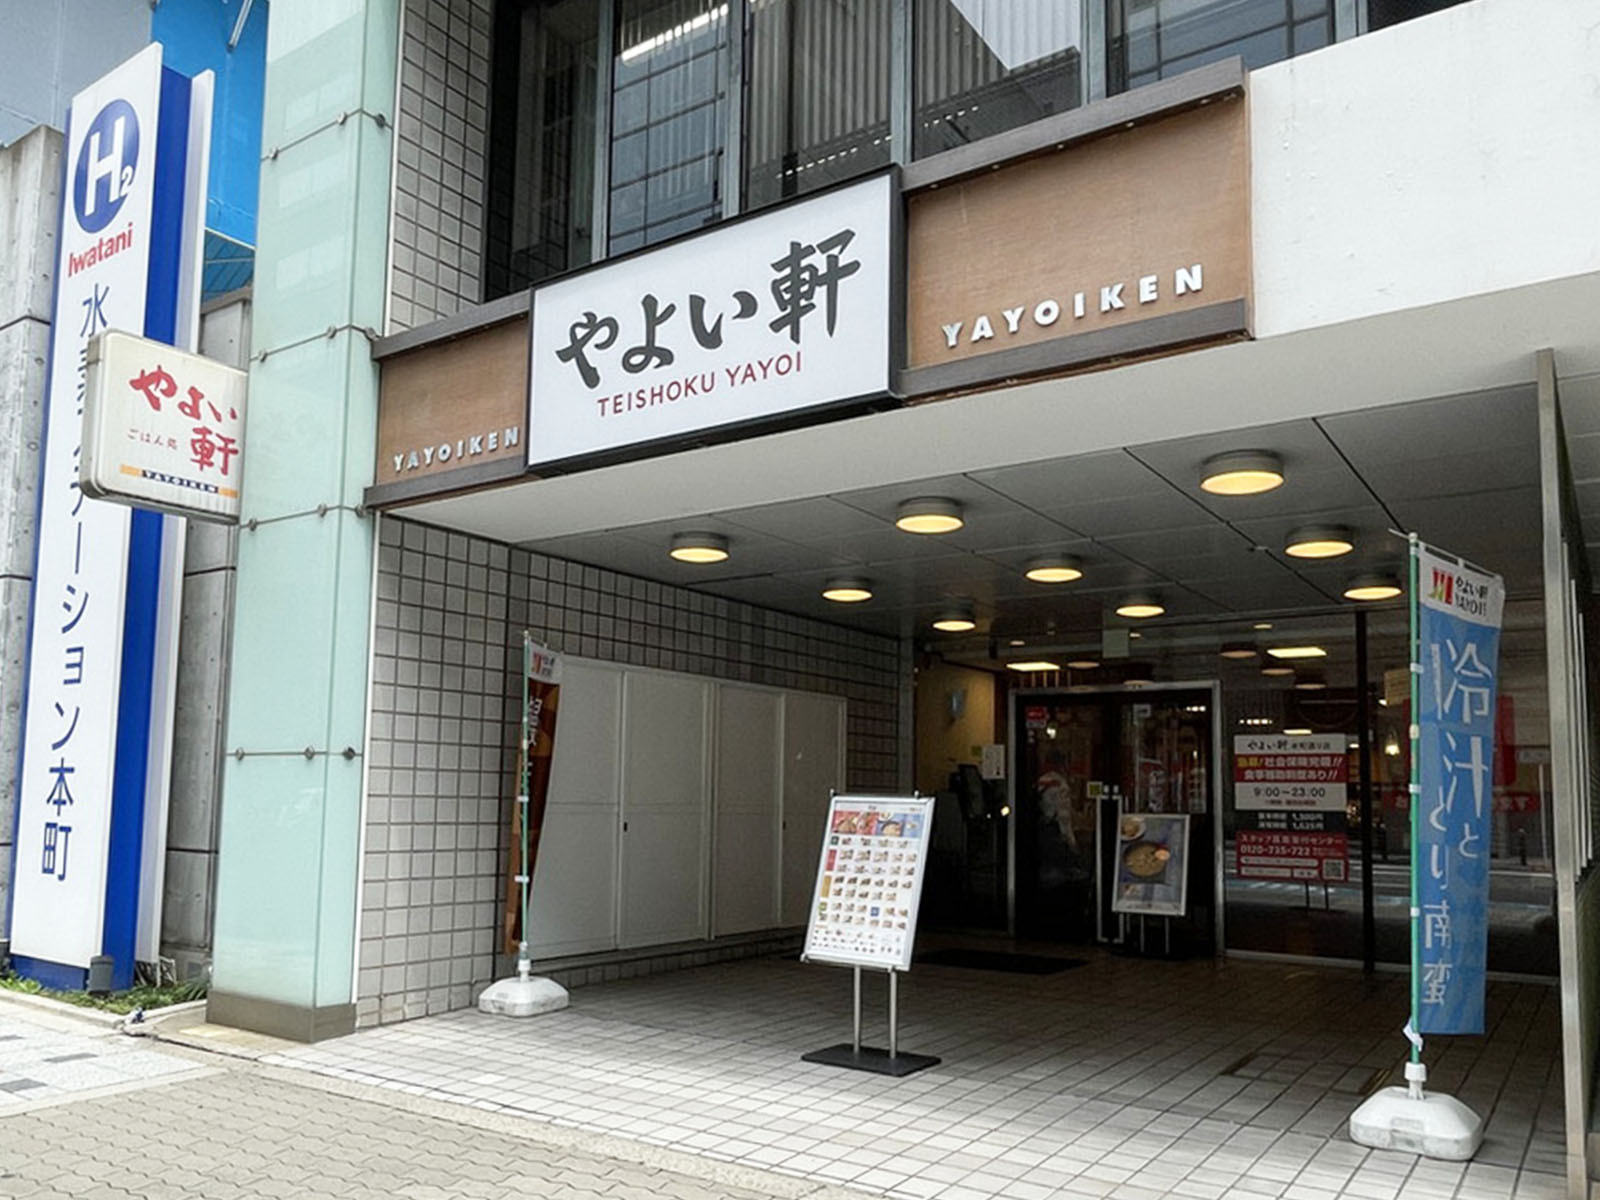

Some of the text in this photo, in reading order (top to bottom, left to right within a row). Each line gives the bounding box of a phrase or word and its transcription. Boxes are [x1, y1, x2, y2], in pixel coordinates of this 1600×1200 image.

[68, 222, 133, 277] Iwatani
[556, 228, 861, 389] やよい軒
[941, 263, 1203, 348] YAYOIKEN
[597, 351, 802, 417] TEISHOKU YAYOI
[393, 426, 520, 473] YAYOIKEN
